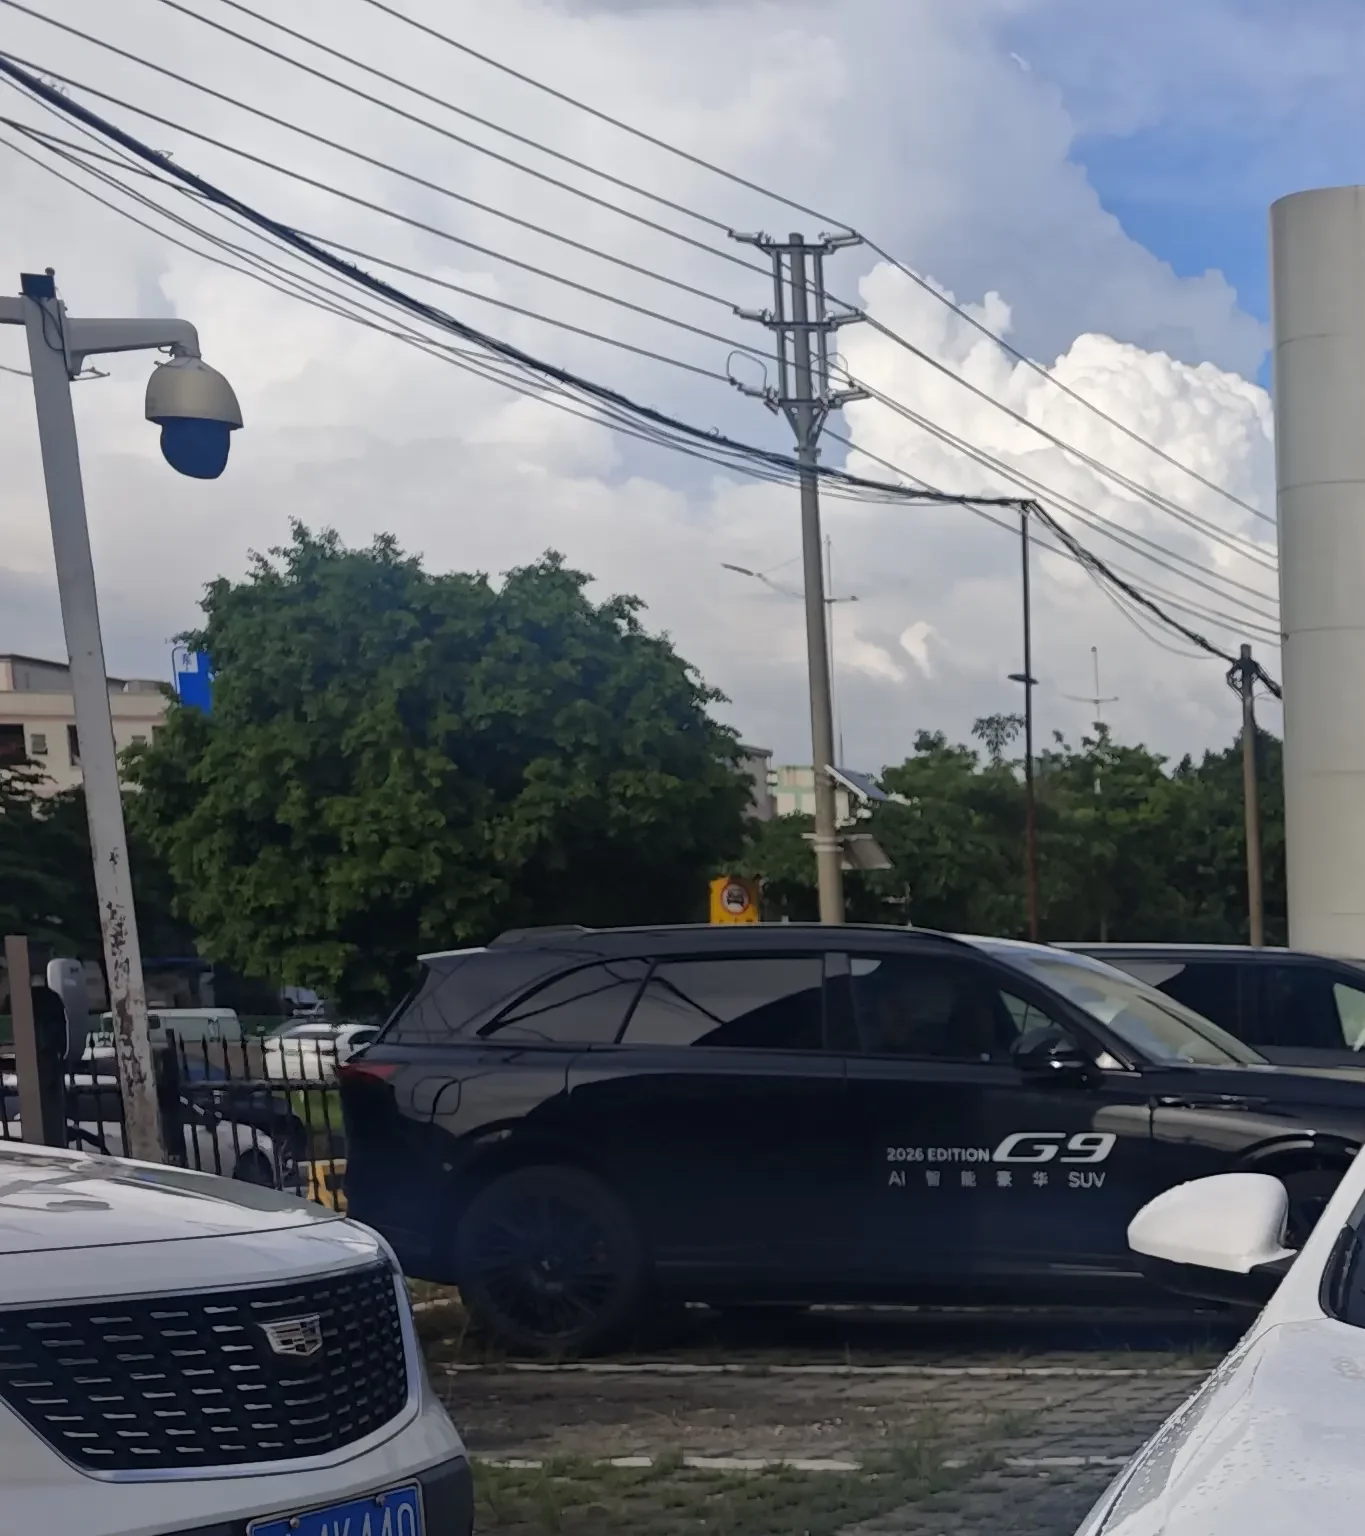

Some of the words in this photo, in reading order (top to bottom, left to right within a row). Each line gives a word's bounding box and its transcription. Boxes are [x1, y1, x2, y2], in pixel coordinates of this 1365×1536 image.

[886, 1147, 925, 1162] 2026
[927, 1147, 990, 1162] EDITION
[992, 1131, 1117, 1163] G9
[888, 1171, 907, 1187] AI
[1067, 1170, 1106, 1189] SUV
